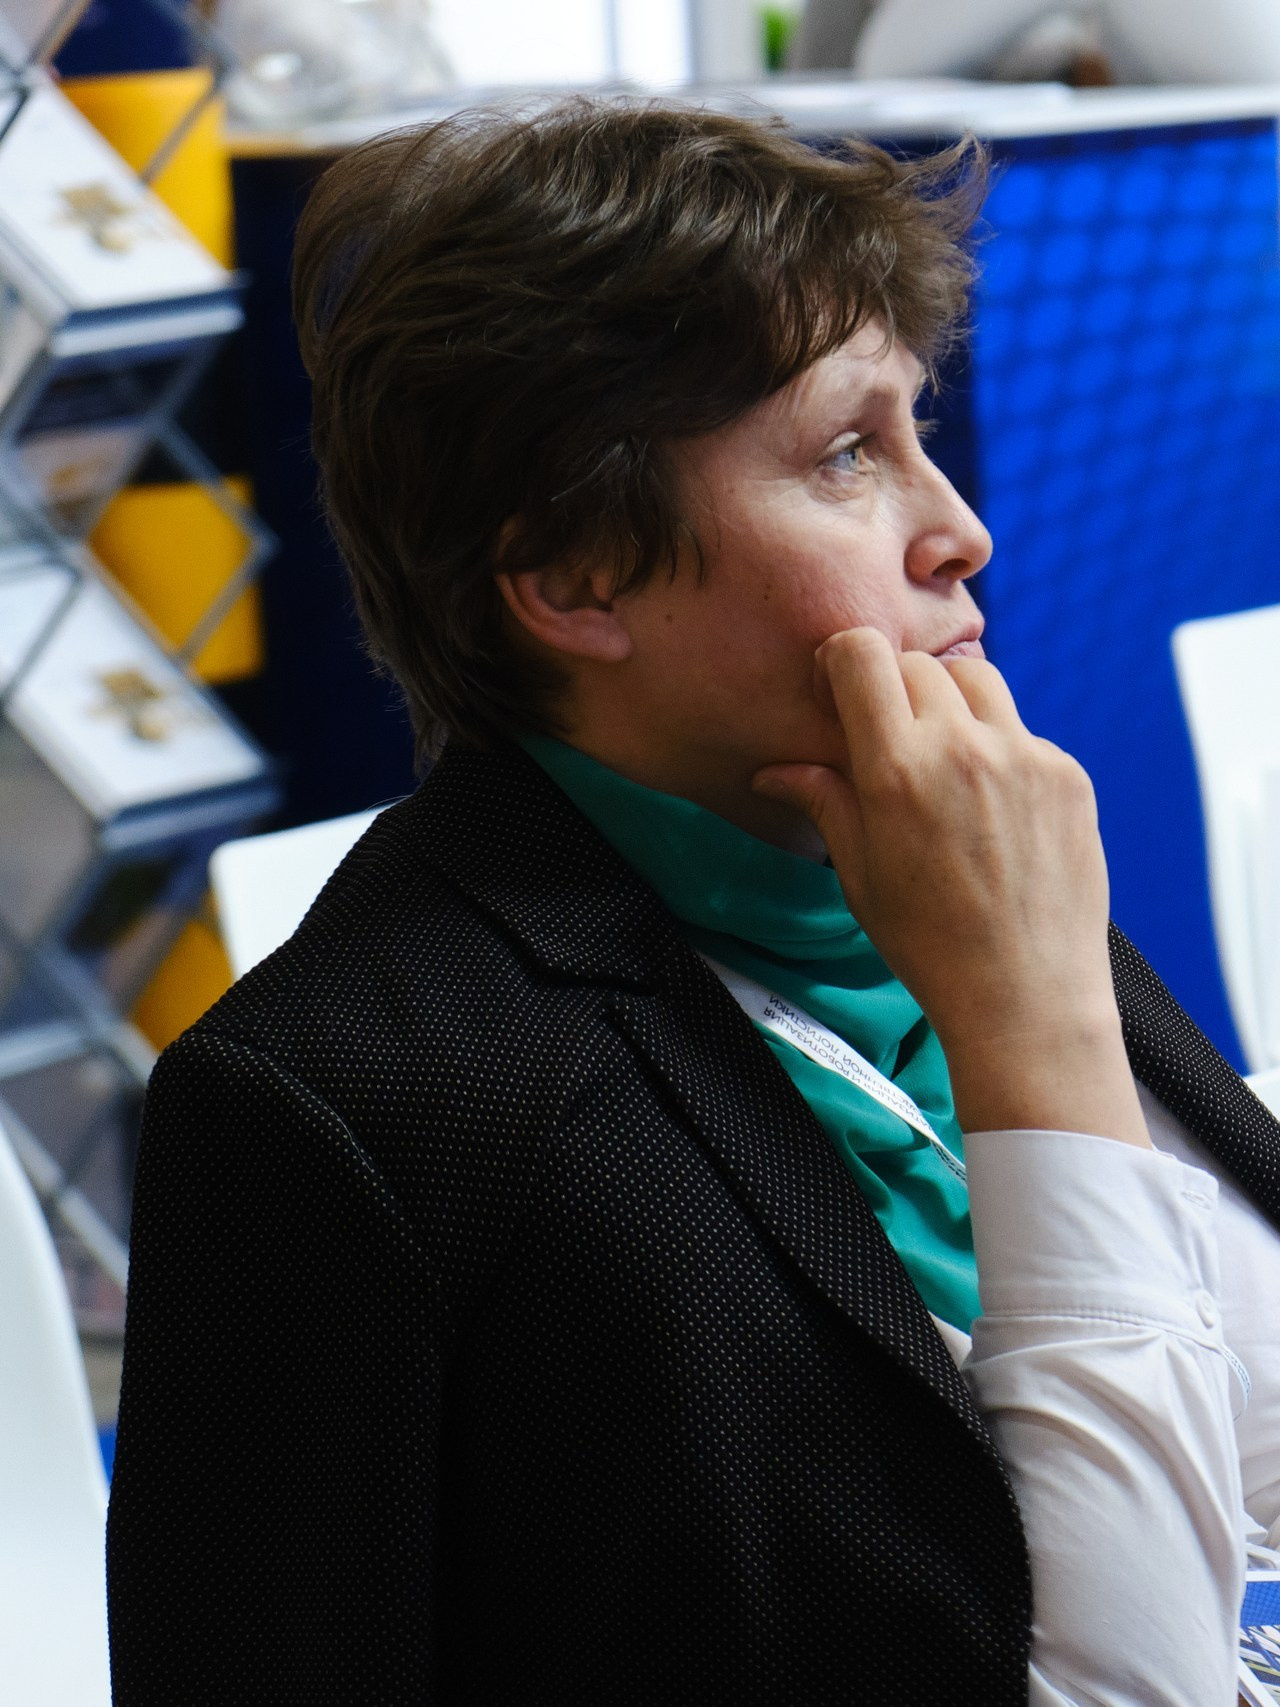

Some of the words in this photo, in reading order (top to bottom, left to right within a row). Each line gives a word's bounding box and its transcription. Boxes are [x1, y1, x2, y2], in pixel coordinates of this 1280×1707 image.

[762, 1006, 851, 1075] РОБОТИЗАЦИЯ
[768, 995, 840, 1055] ЛОГИСТИКИ
[863, 1082, 928, 1129] АТИЗАЦИЯ
